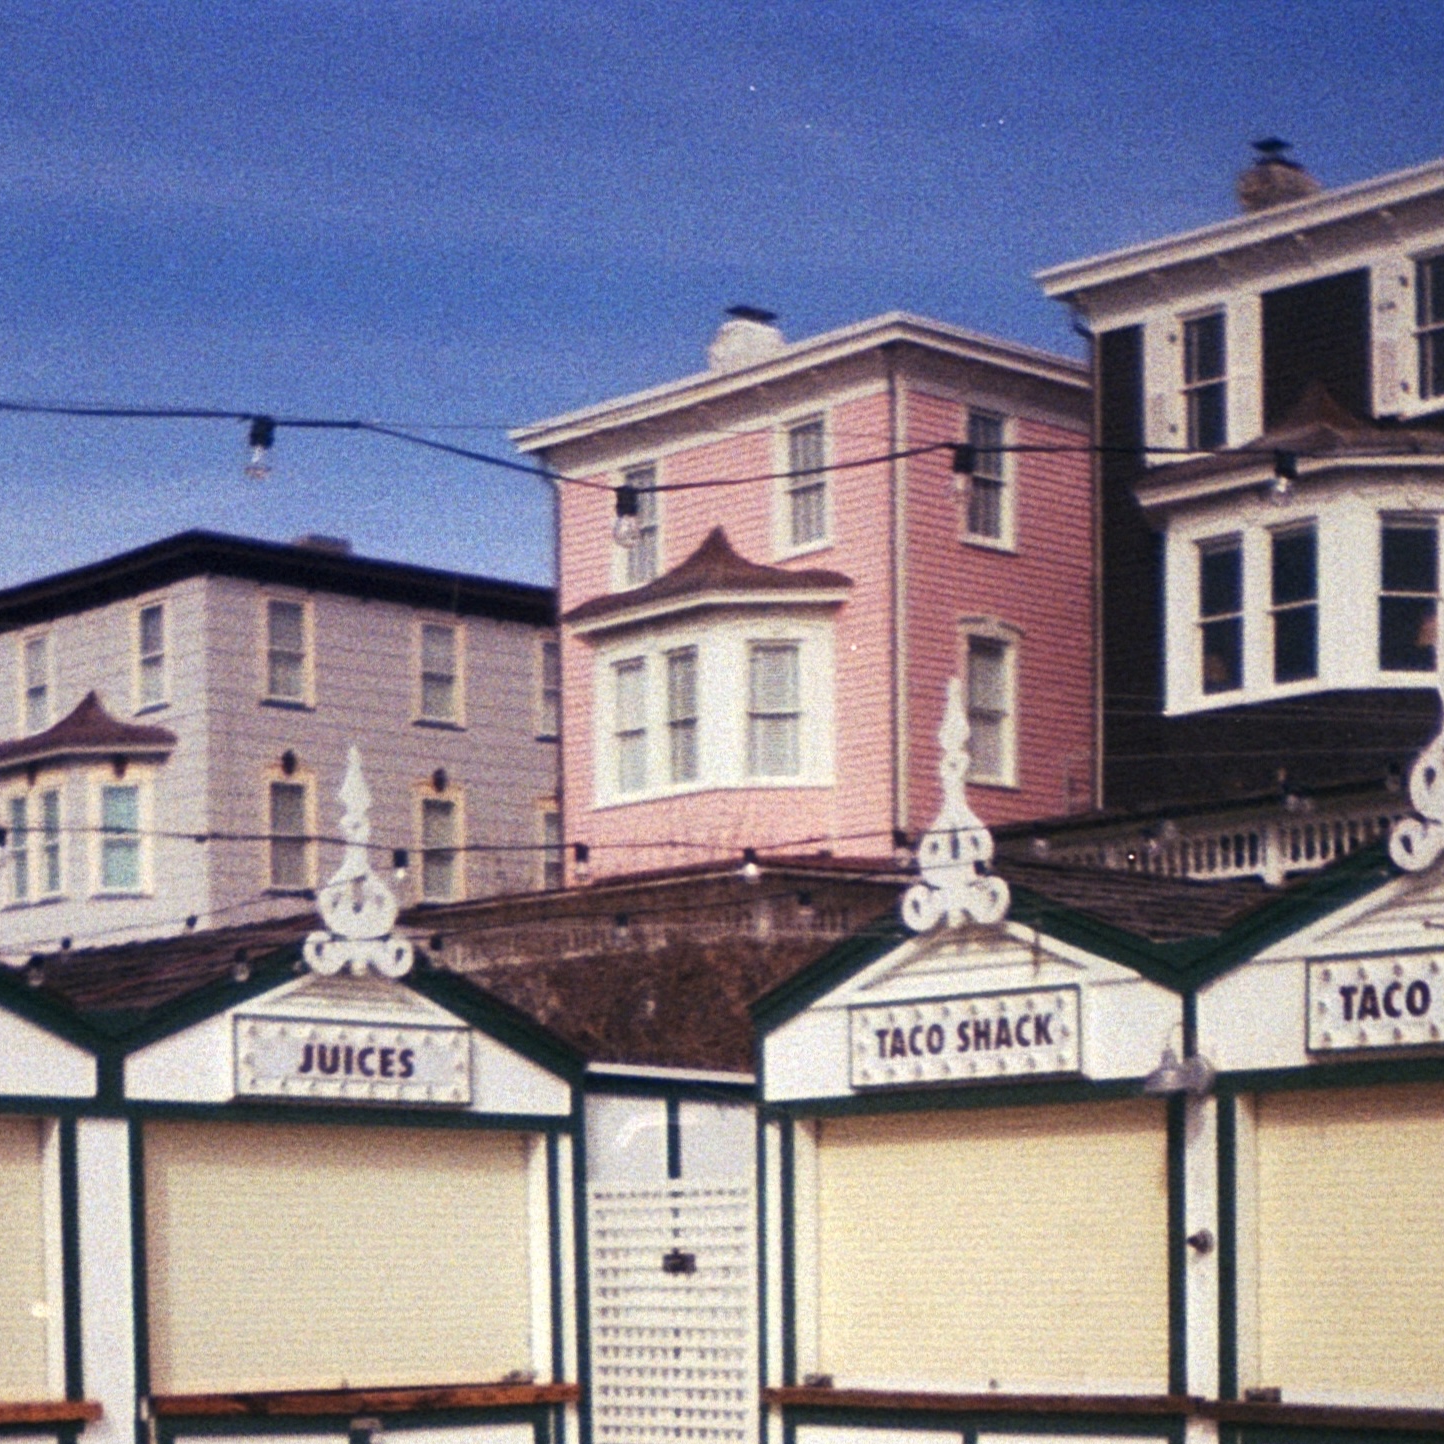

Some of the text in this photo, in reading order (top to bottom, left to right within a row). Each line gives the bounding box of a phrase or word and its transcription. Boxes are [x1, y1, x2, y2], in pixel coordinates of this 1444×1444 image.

[1339, 979, 1431, 1021] TACO
[875, 1013, 1053, 1058] TACO SHACK
[299, 1043, 415, 1077] JUICES
